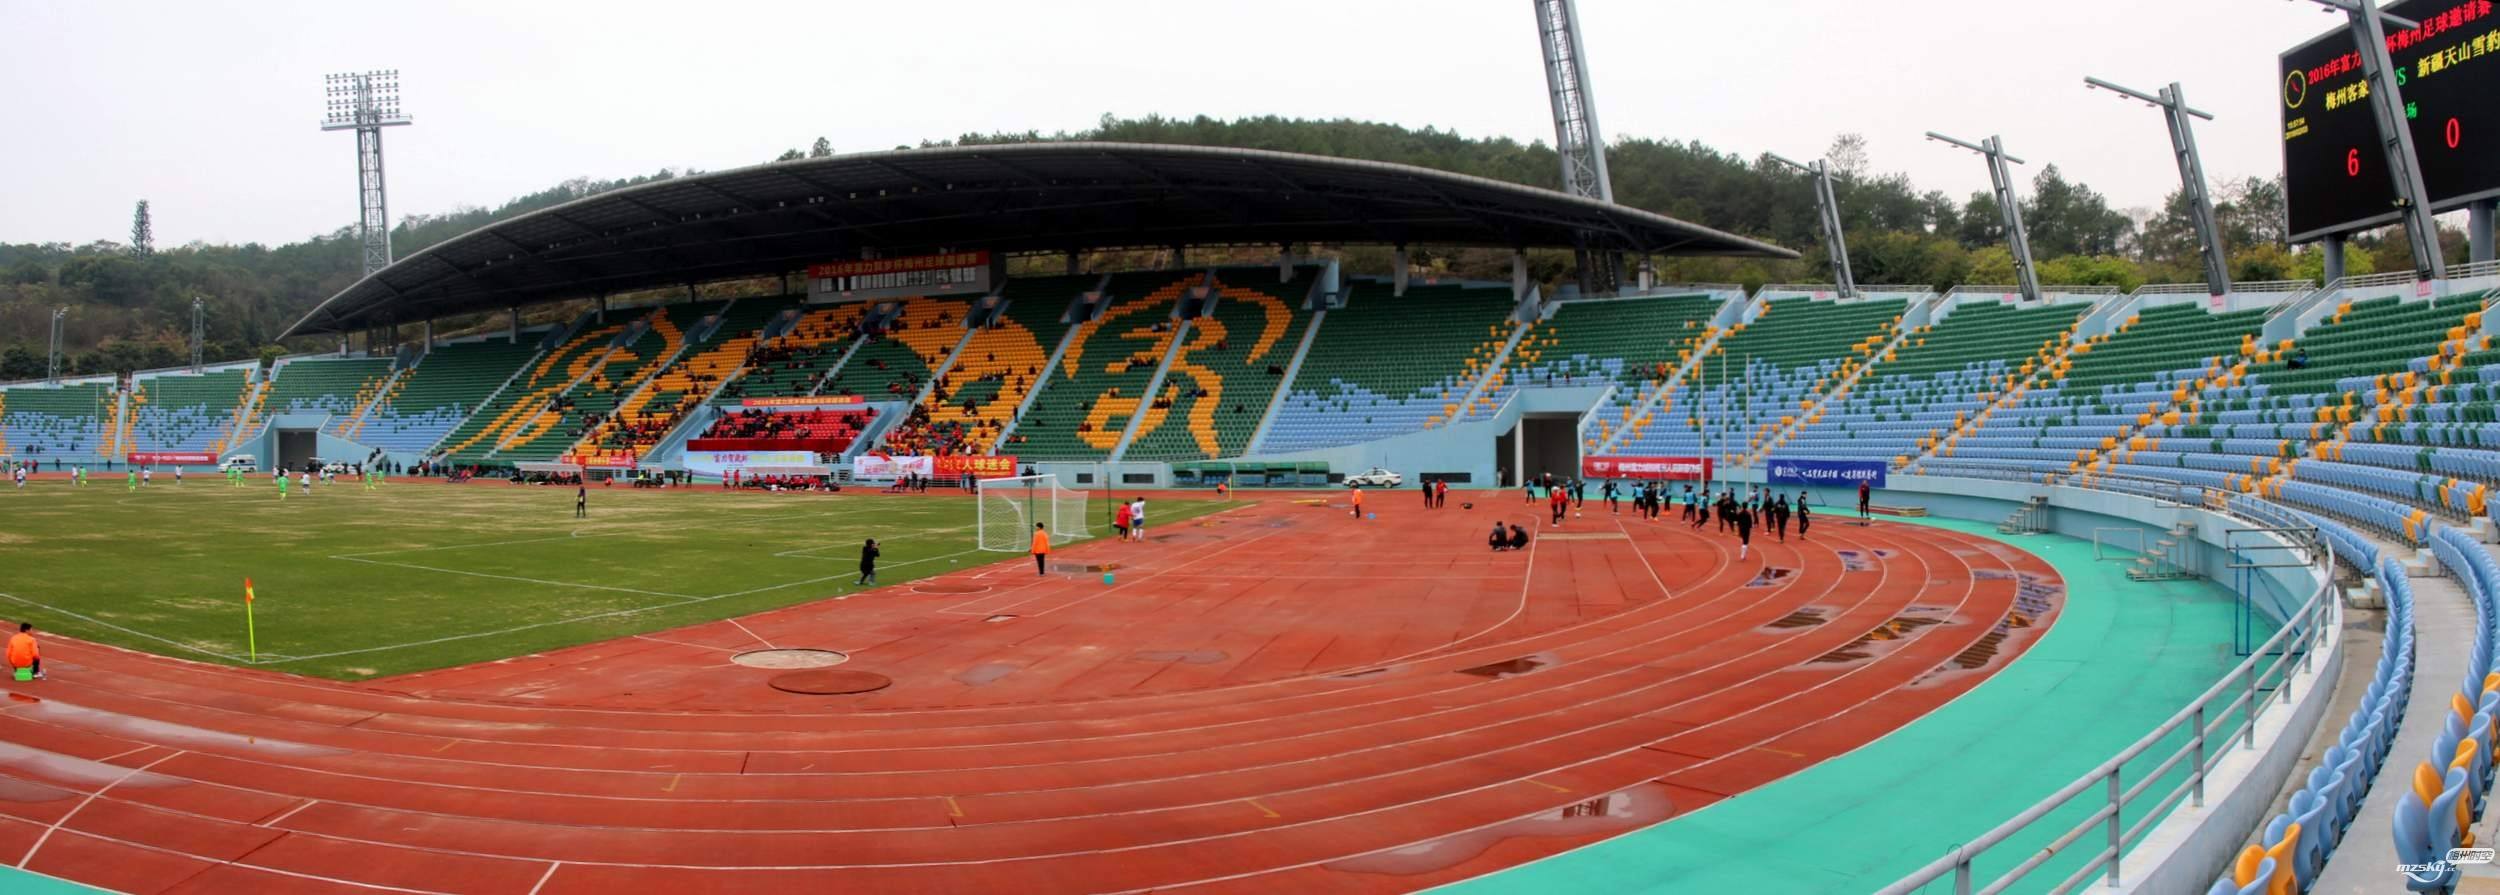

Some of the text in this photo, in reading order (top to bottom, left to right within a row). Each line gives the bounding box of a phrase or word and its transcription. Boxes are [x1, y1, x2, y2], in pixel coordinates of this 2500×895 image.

[2308, 0, 2492, 85] 2016年富力杯梅州足球邀请赛
[2418, 28, 2500, 78] 新疆天山雪豹
[2446, 117, 2460, 149] 0
[2347, 148, 2360, 176] 6
